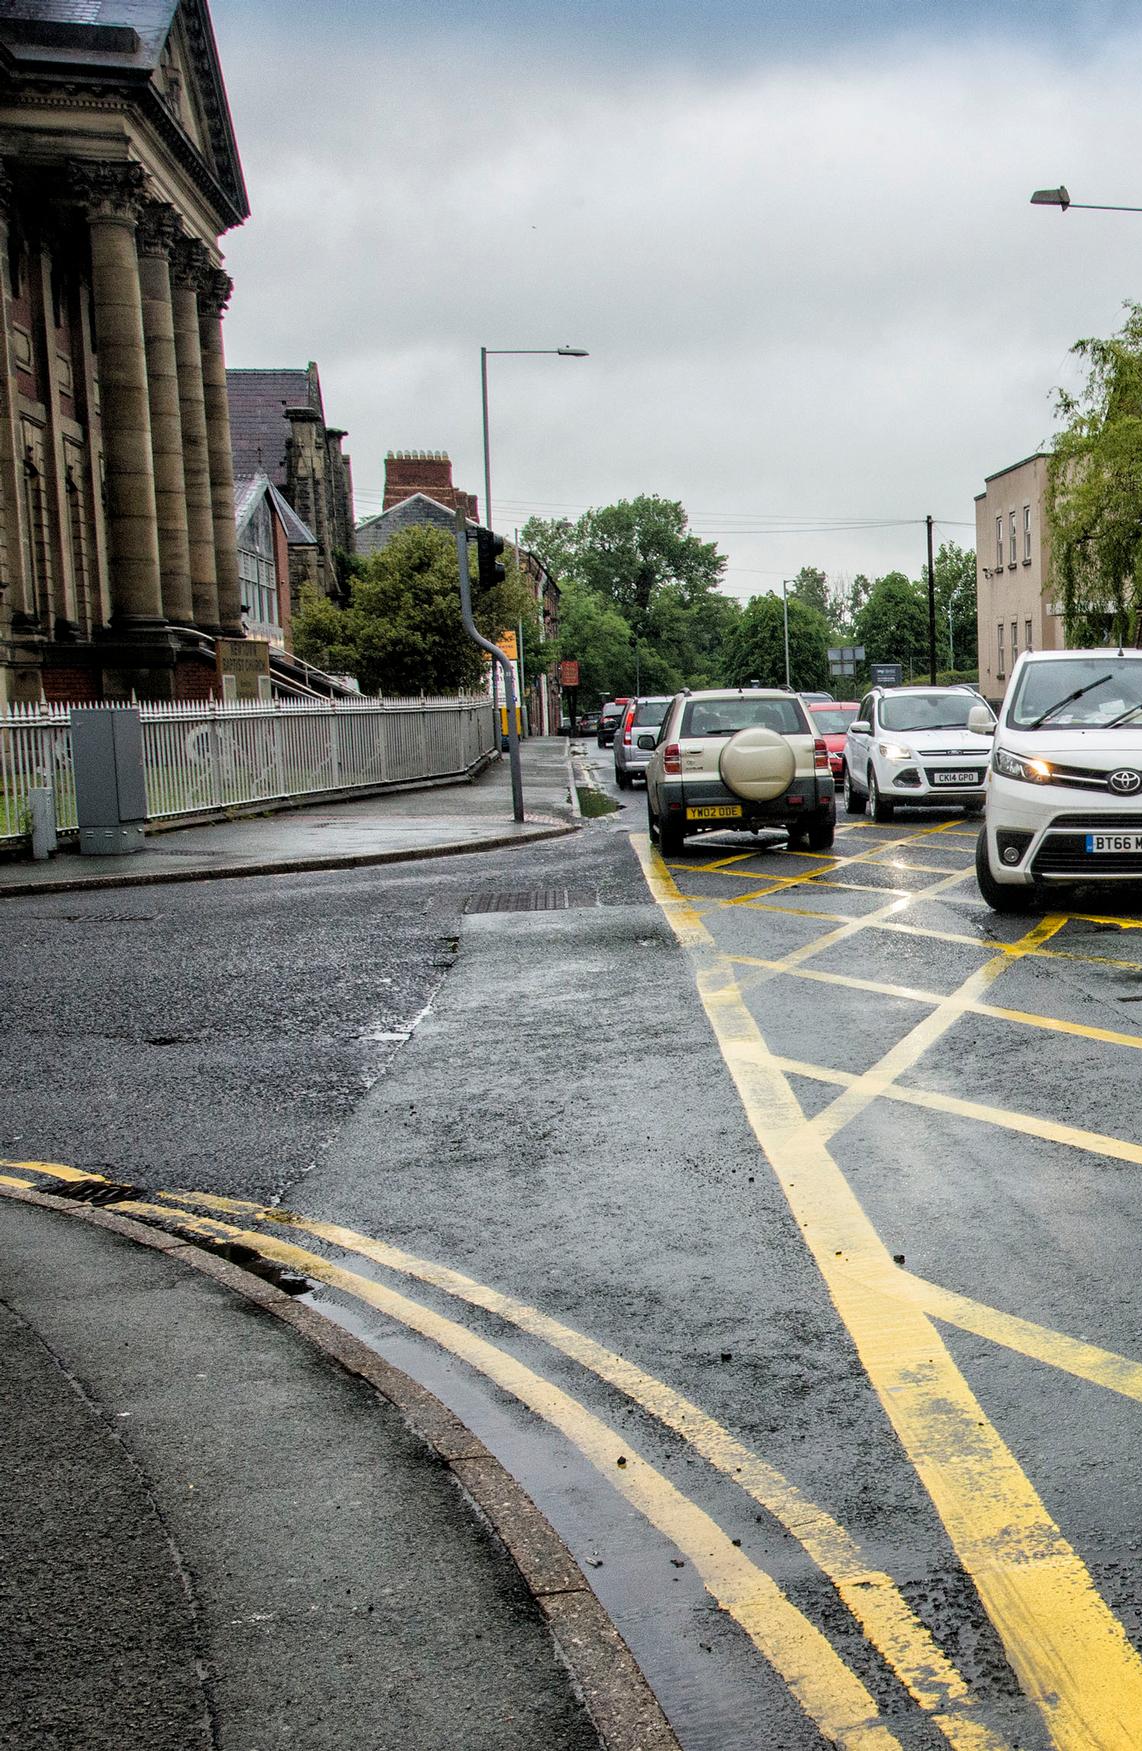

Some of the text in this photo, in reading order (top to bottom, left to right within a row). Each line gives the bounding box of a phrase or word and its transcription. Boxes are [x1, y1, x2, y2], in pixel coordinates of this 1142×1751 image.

[939, 774, 957, 782] CK14
[718, 806, 738, 817] ODE
[1096, 836, 1132, 850] BT66
